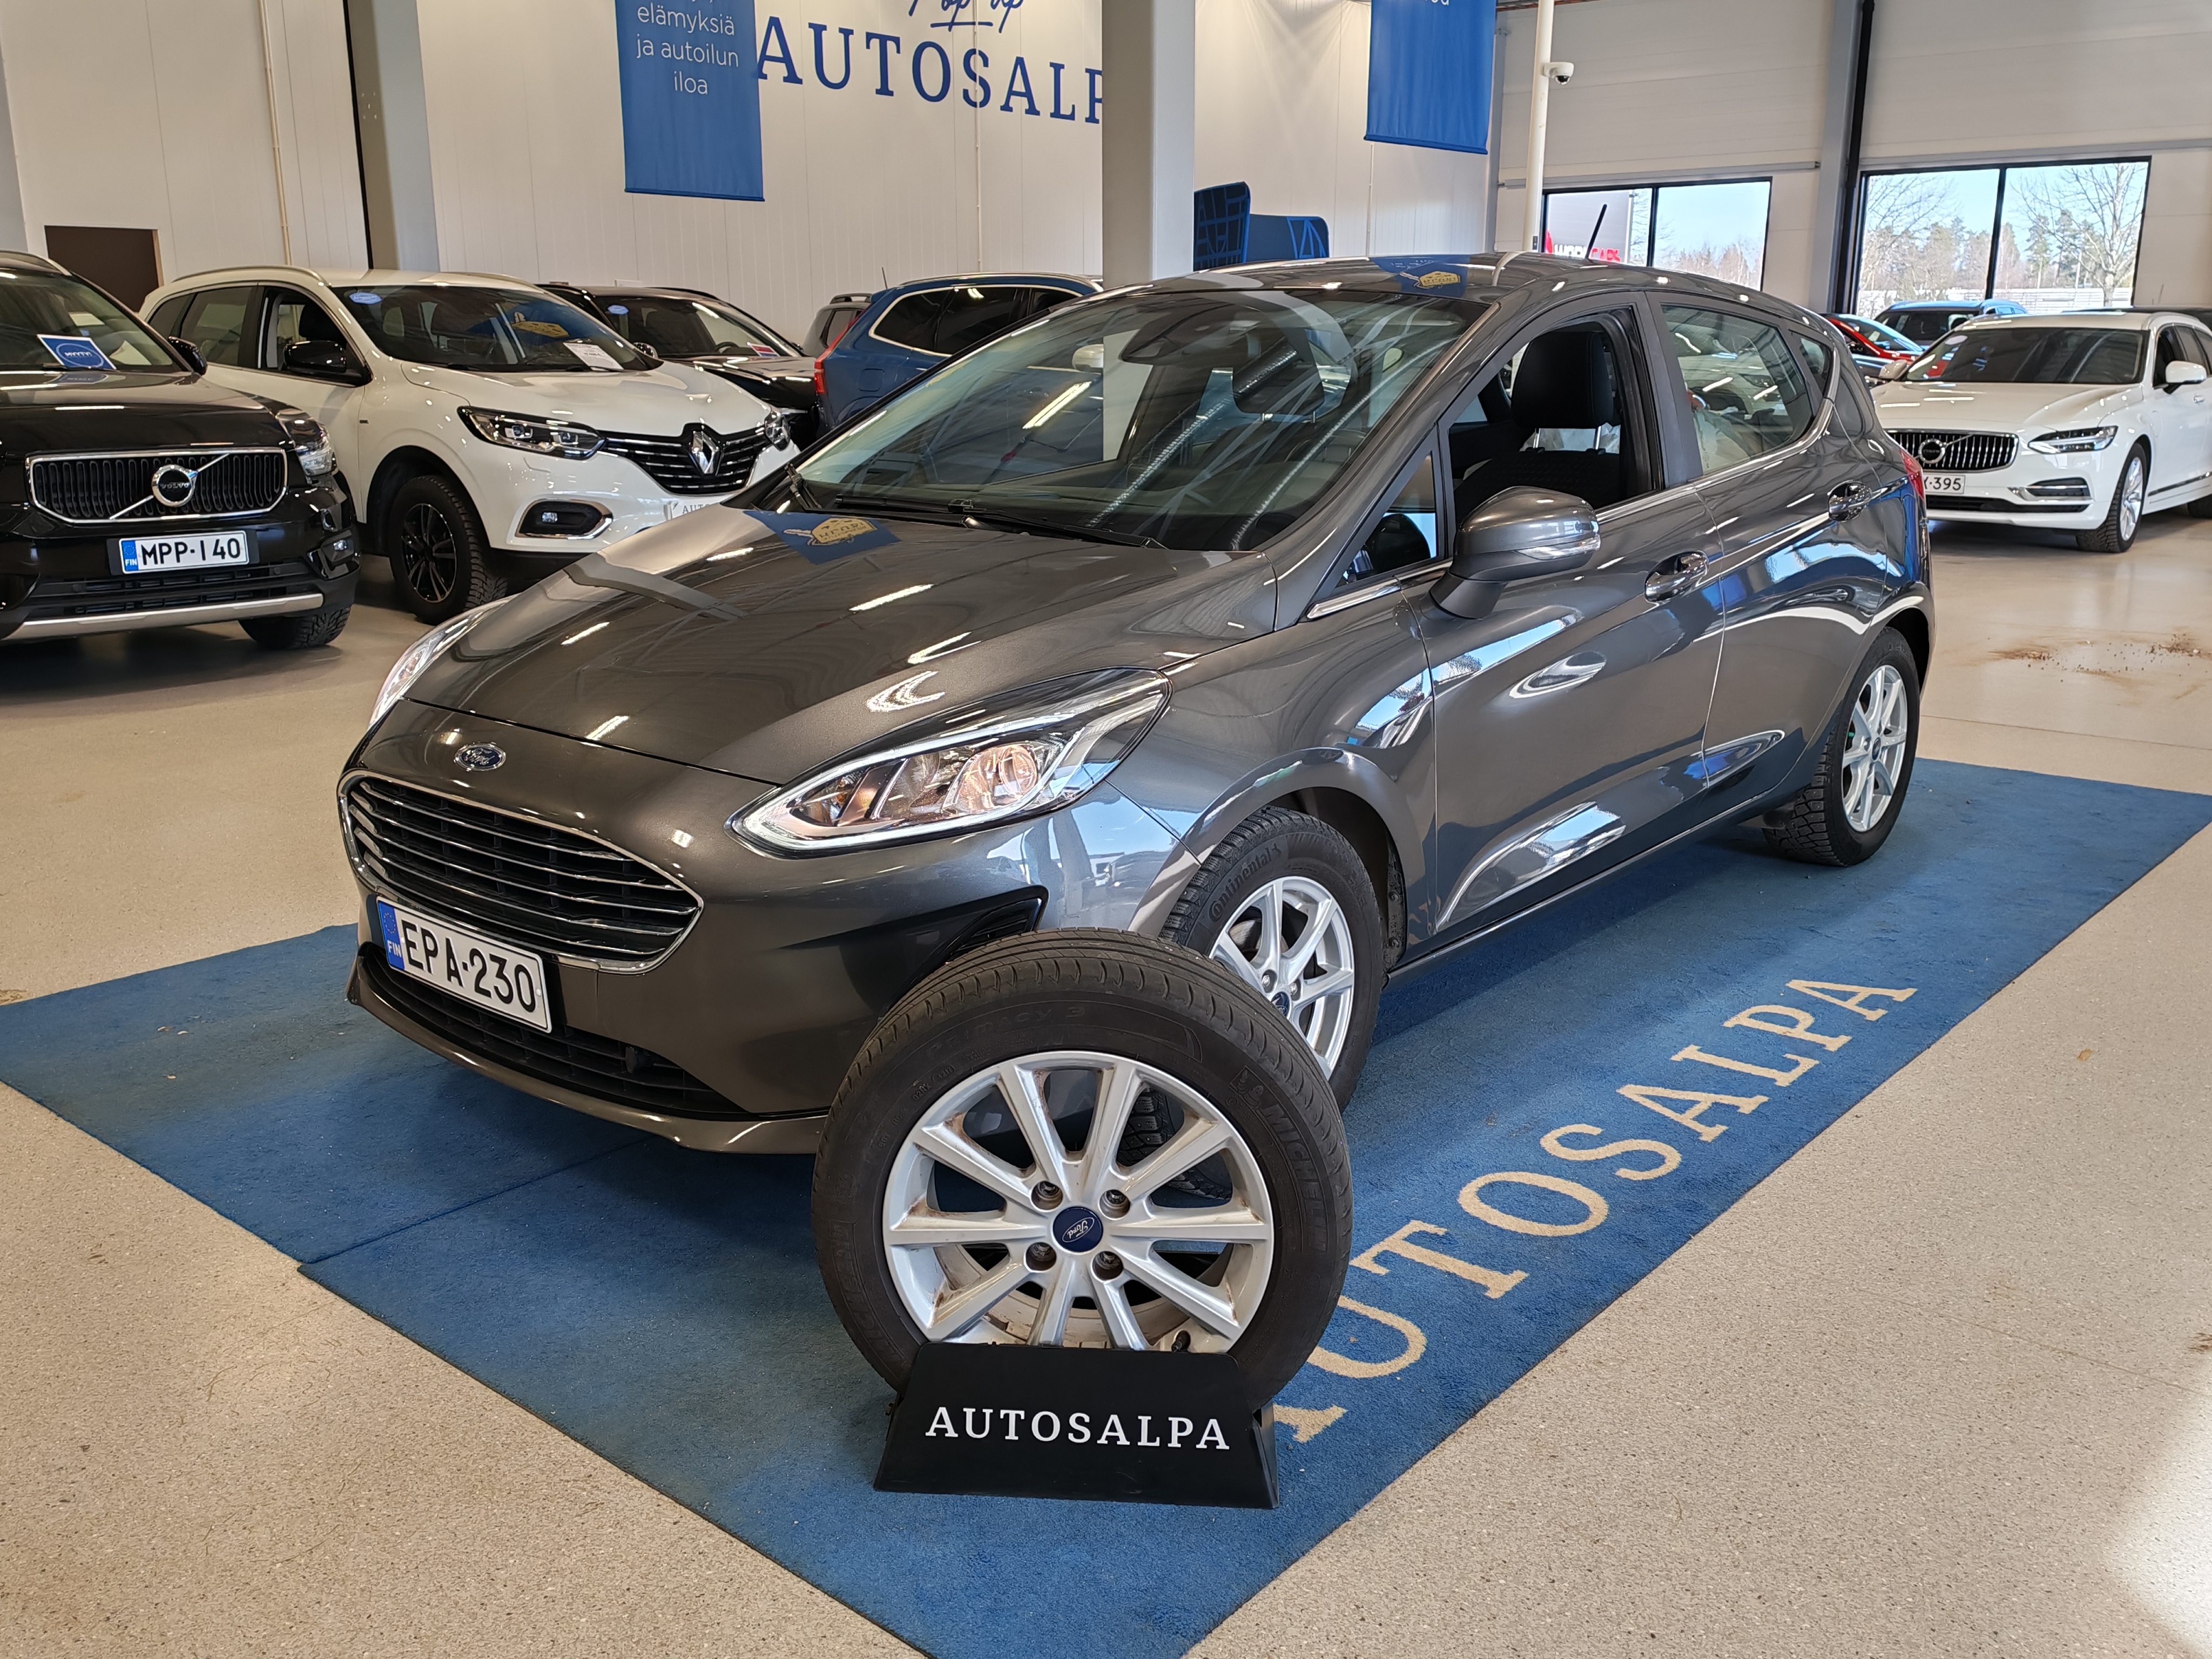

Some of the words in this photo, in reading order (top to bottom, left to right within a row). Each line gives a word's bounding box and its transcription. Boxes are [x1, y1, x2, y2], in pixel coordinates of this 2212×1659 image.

[637, 2, 734, 36] elämyksiä
[636, 33, 654, 59] ja
[661, 42, 739, 68] autoilun
[673, 71, 708, 95] iloa
[125, 558, 138, 567] FIN
[141, 538, 241, 566] MPP-140
[1209, 846, 1272, 922] Continental
[387, 939, 402, 959] FIN
[401, 920, 537, 1013] EPA-230
[1067, 1220, 1089, 1239] Ford
[925, 1406, 1230, 1451] AUTOSALPA
